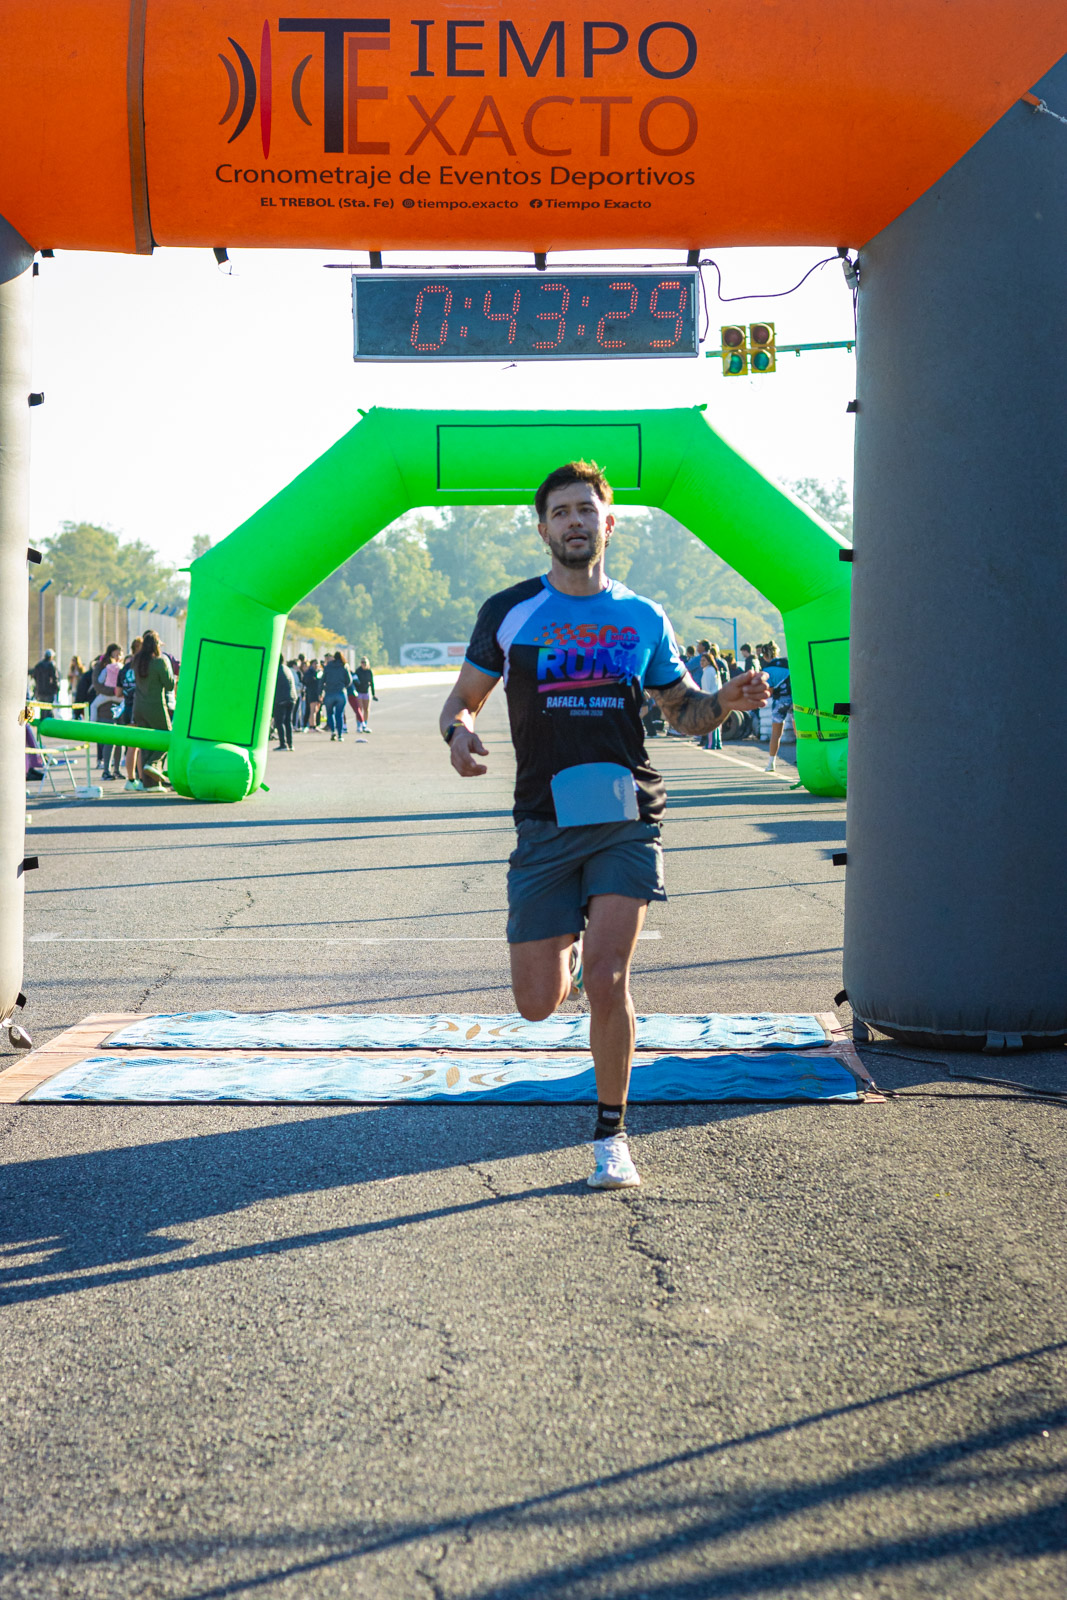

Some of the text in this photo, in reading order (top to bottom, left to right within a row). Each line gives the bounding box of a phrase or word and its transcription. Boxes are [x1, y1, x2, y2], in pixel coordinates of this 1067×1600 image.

[215, 164, 696, 189] Cronometraje de Eventos Deportivos
[260, 197, 652, 211] EL TREBOL (Sta. Fe) tiempo.exacto Tiempo Exacto
[410, 281, 688, 350] 0:43:29
[546, 696, 587, 708] RAFAELA,
[589, 696, 616, 708] SANTA
